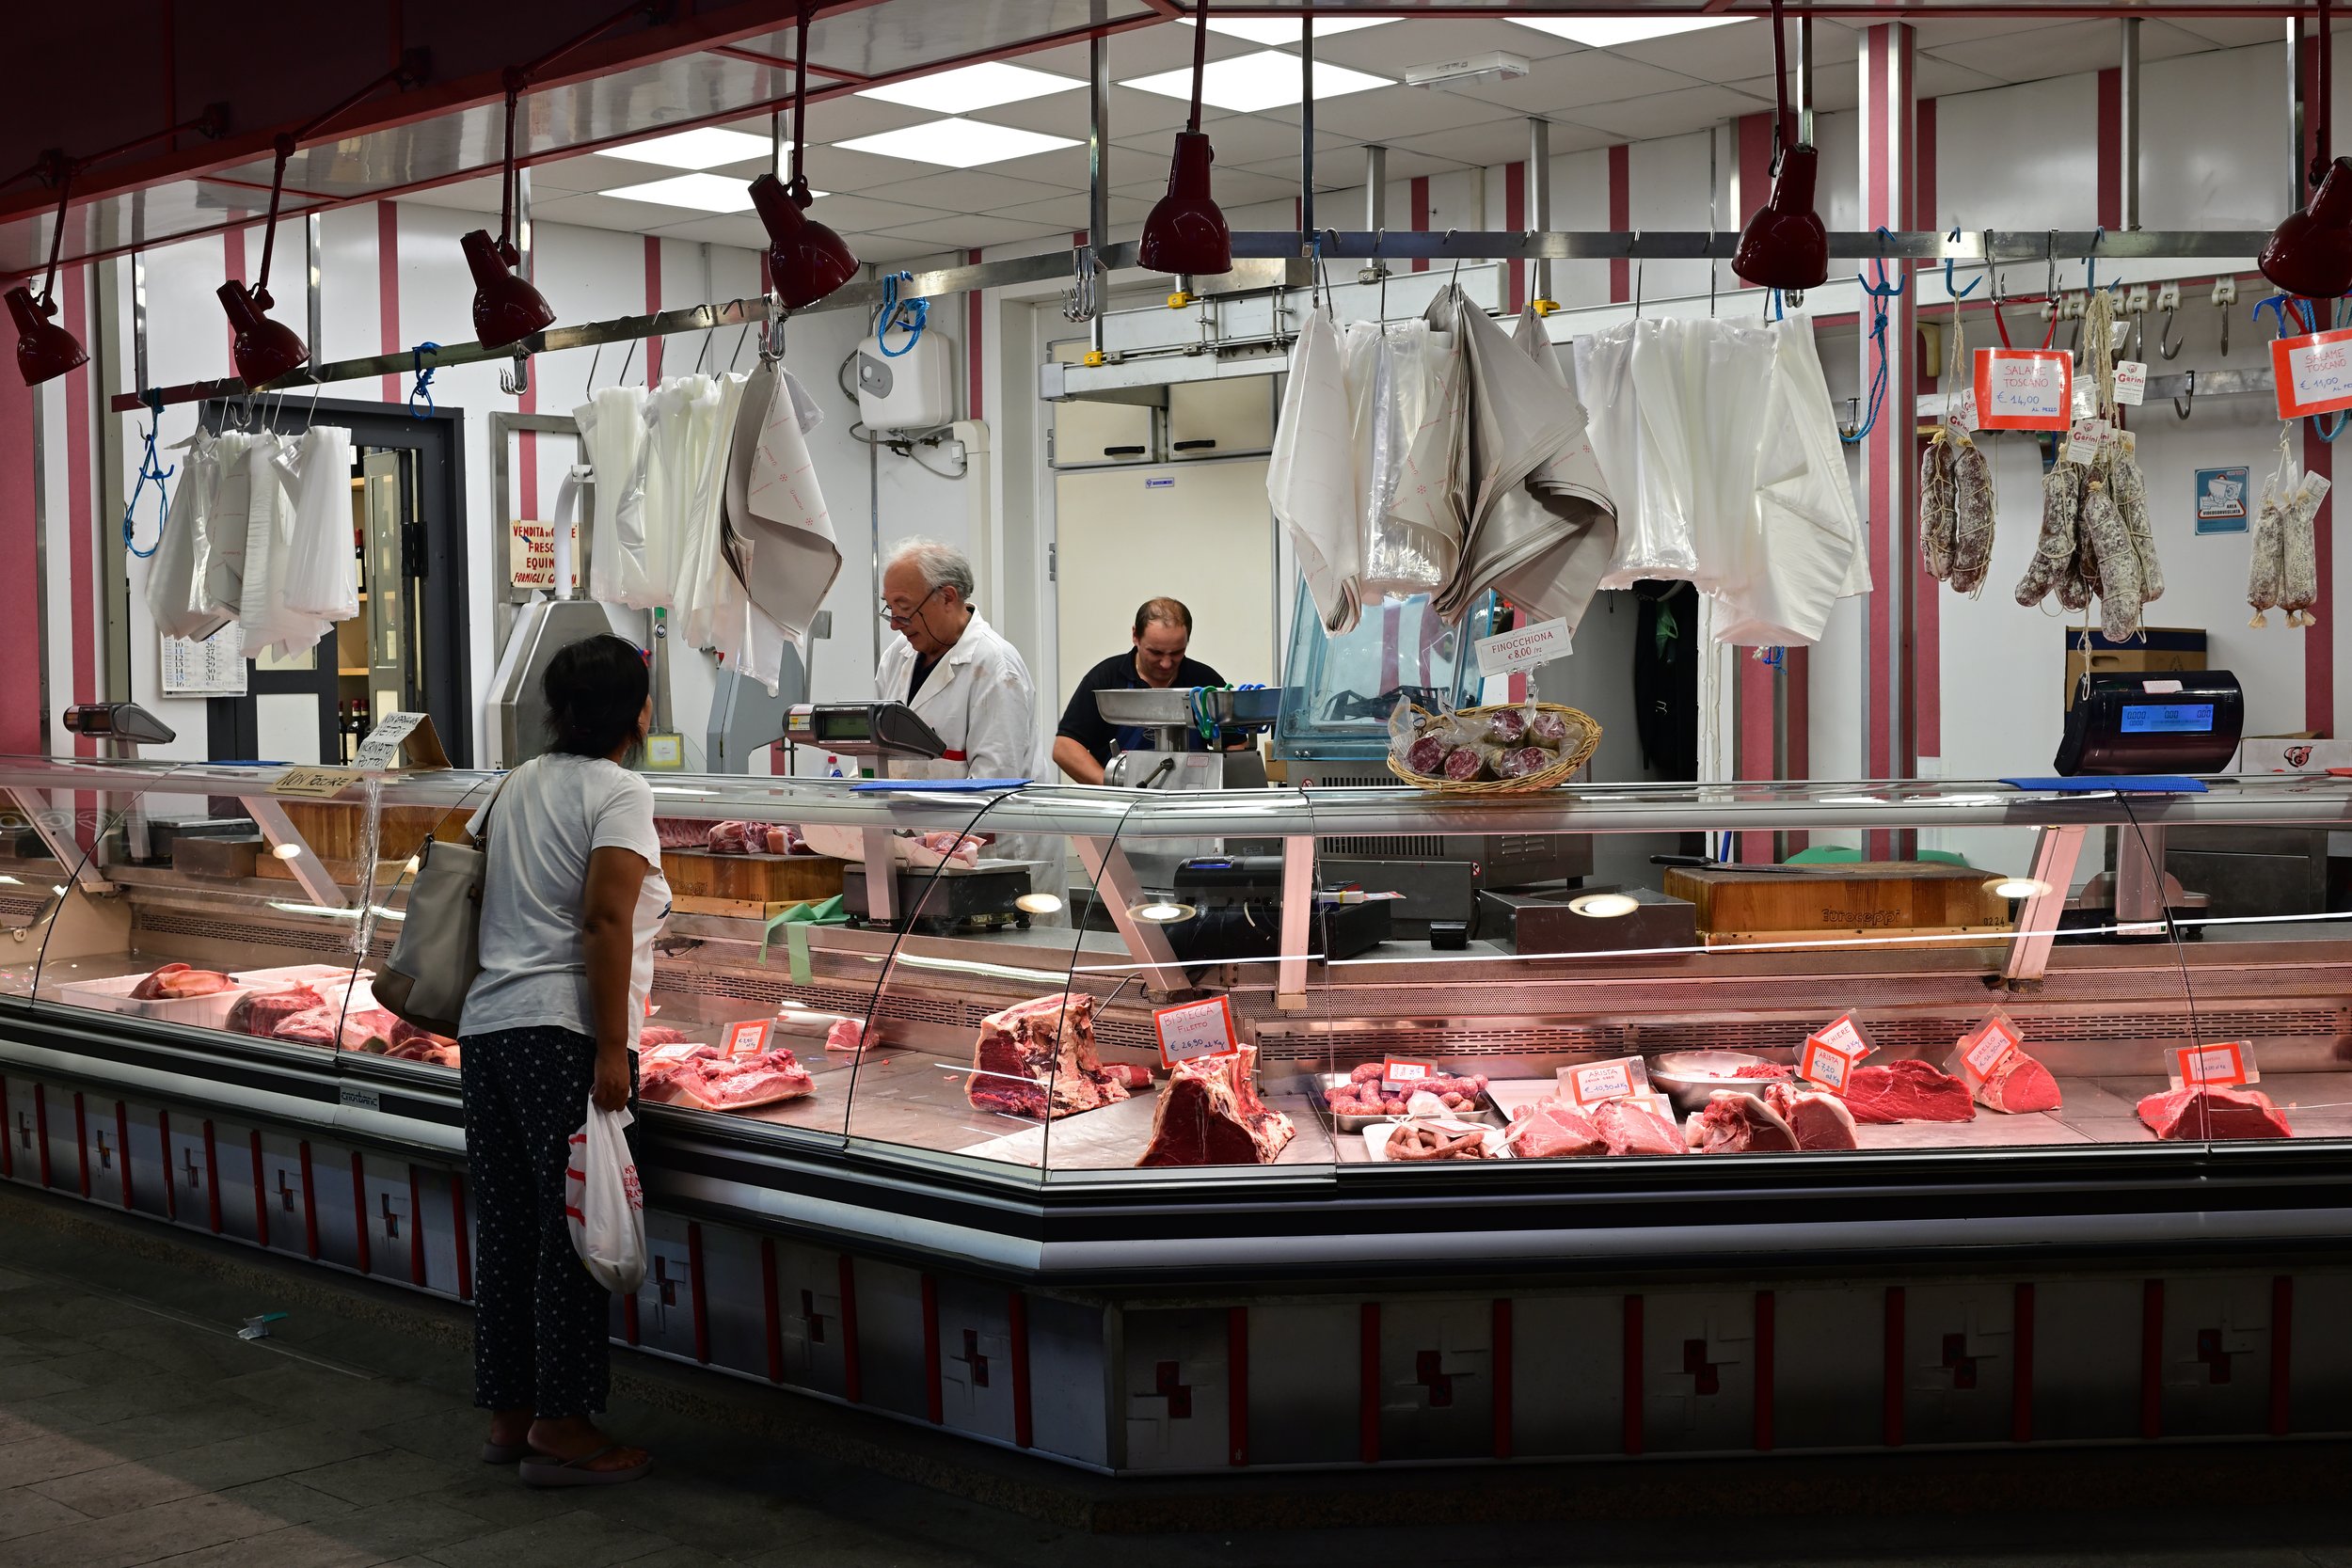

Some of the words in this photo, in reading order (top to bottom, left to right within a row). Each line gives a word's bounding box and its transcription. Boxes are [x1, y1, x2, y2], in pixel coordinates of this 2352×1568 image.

[2305, 348, 2345, 364] SALAME
[2005, 365, 2046, 375] SALAME
[2305, 358, 2346, 372] TOSCANO
[2004, 378, 2048, 388] TOSCANO
[2118, 373, 2144, 384] Garini
[2313, 376, 2339, 388] 11,00
[1997, 391, 2008, 403] €
[2010, 396, 2040, 406] 14,00
[2074, 431, 2098, 443] Garini
[513, 526, 544, 537] VENDITA
[529, 542, 554, 553] FRESC
[527, 558, 555, 570] EQUIN
[1491, 631, 1554, 653] FINOCCHIONA
[1514, 647, 1532, 658] 8,00
[276, 769, 310, 786] NON
[1821, 909, 1900, 926] Euroceppi
[1163, 1006, 1214, 1026] BISTECCA
[1170, 1040, 1179, 1051] €
[1182, 1038, 1203, 1049] 26,90
[1974, 1037, 1995, 1062] GIRELLO
[1819, 1052, 1839, 1066] ARISTA
[1589, 1069, 1617, 1078] ARISTA
[1595, 1084, 1614, 1092] 10,90
